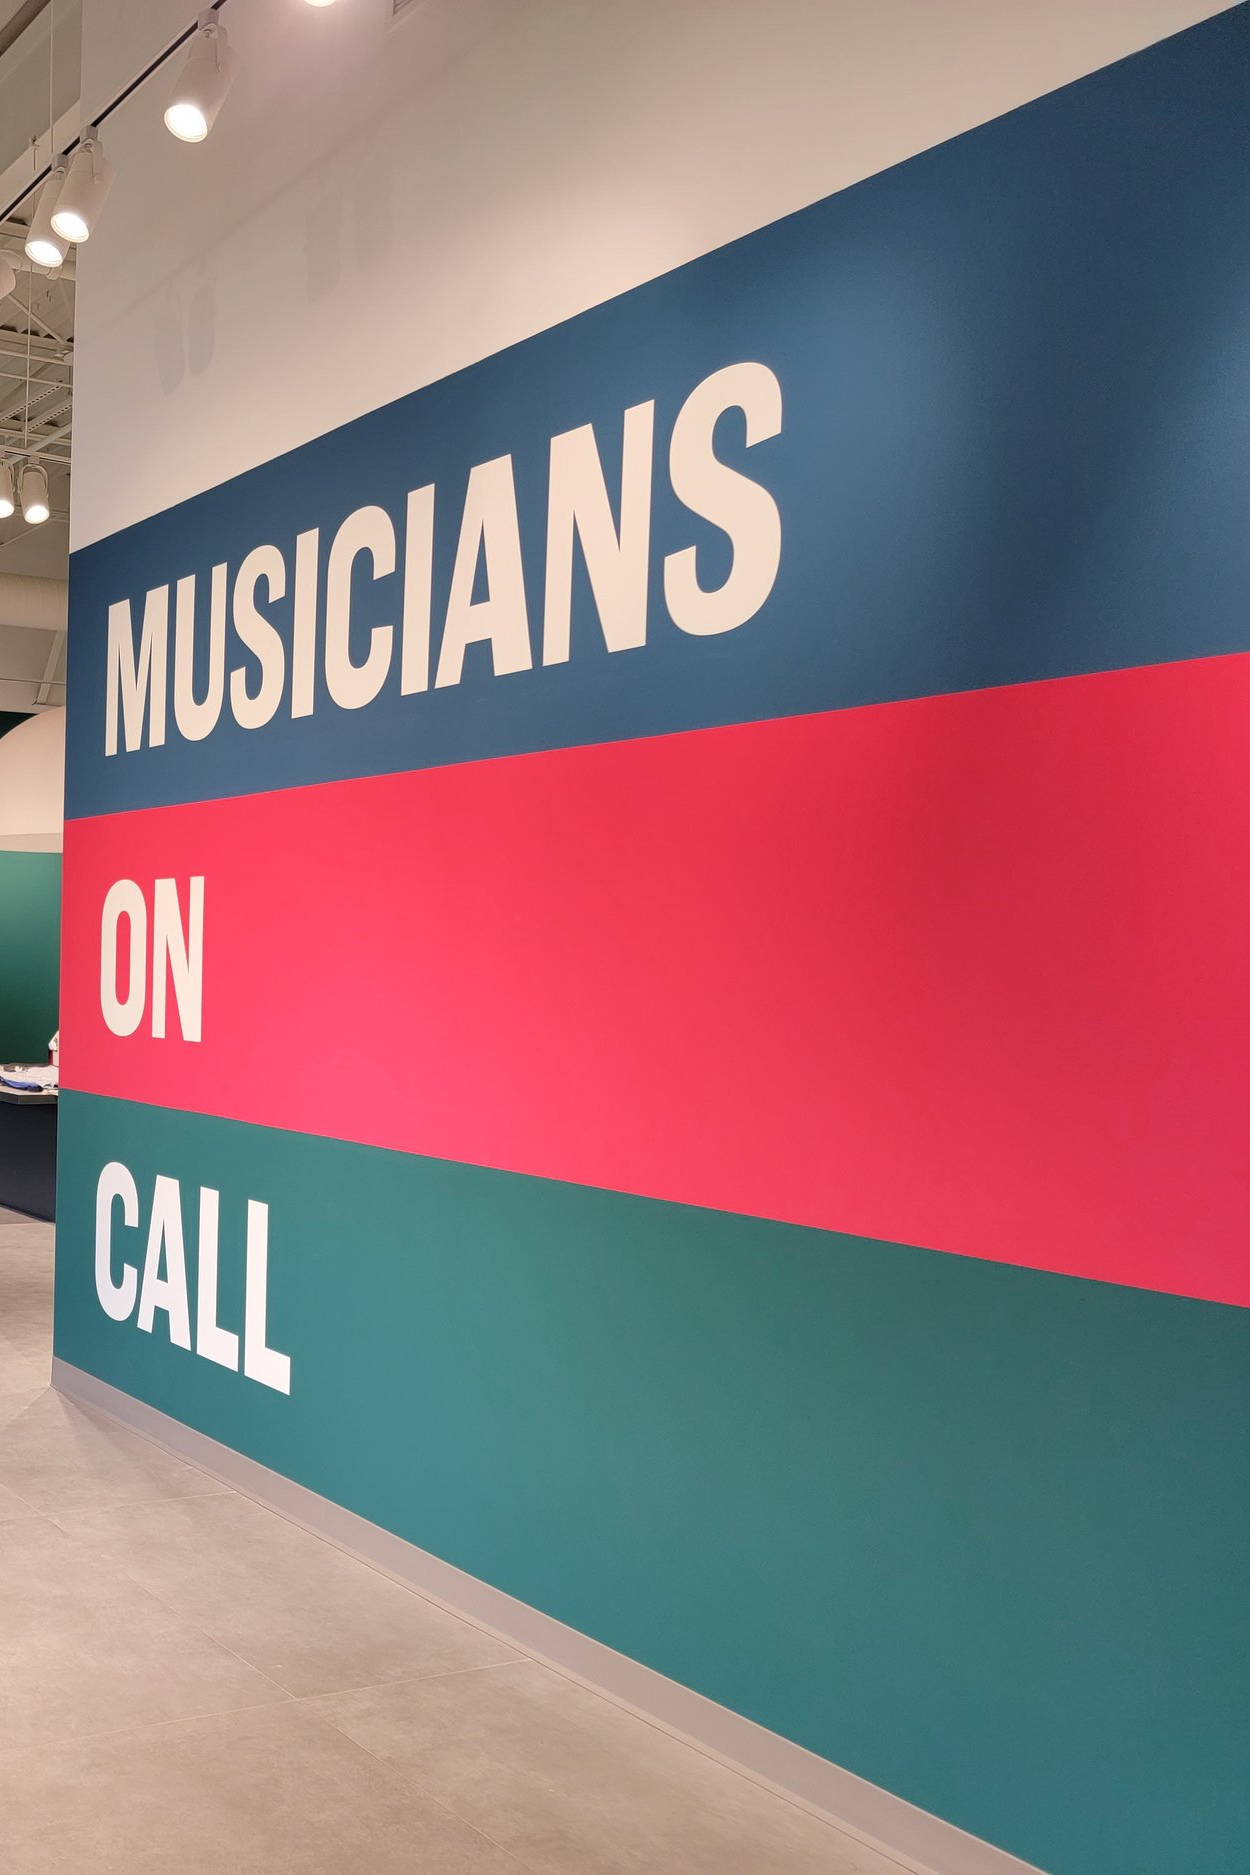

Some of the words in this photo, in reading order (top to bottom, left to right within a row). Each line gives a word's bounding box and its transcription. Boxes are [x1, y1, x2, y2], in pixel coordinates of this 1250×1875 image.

[104, 361, 783, 757] MUSICIANS
[99, 875, 205, 1043] ON
[94, 1161, 291, 1396] CALL
